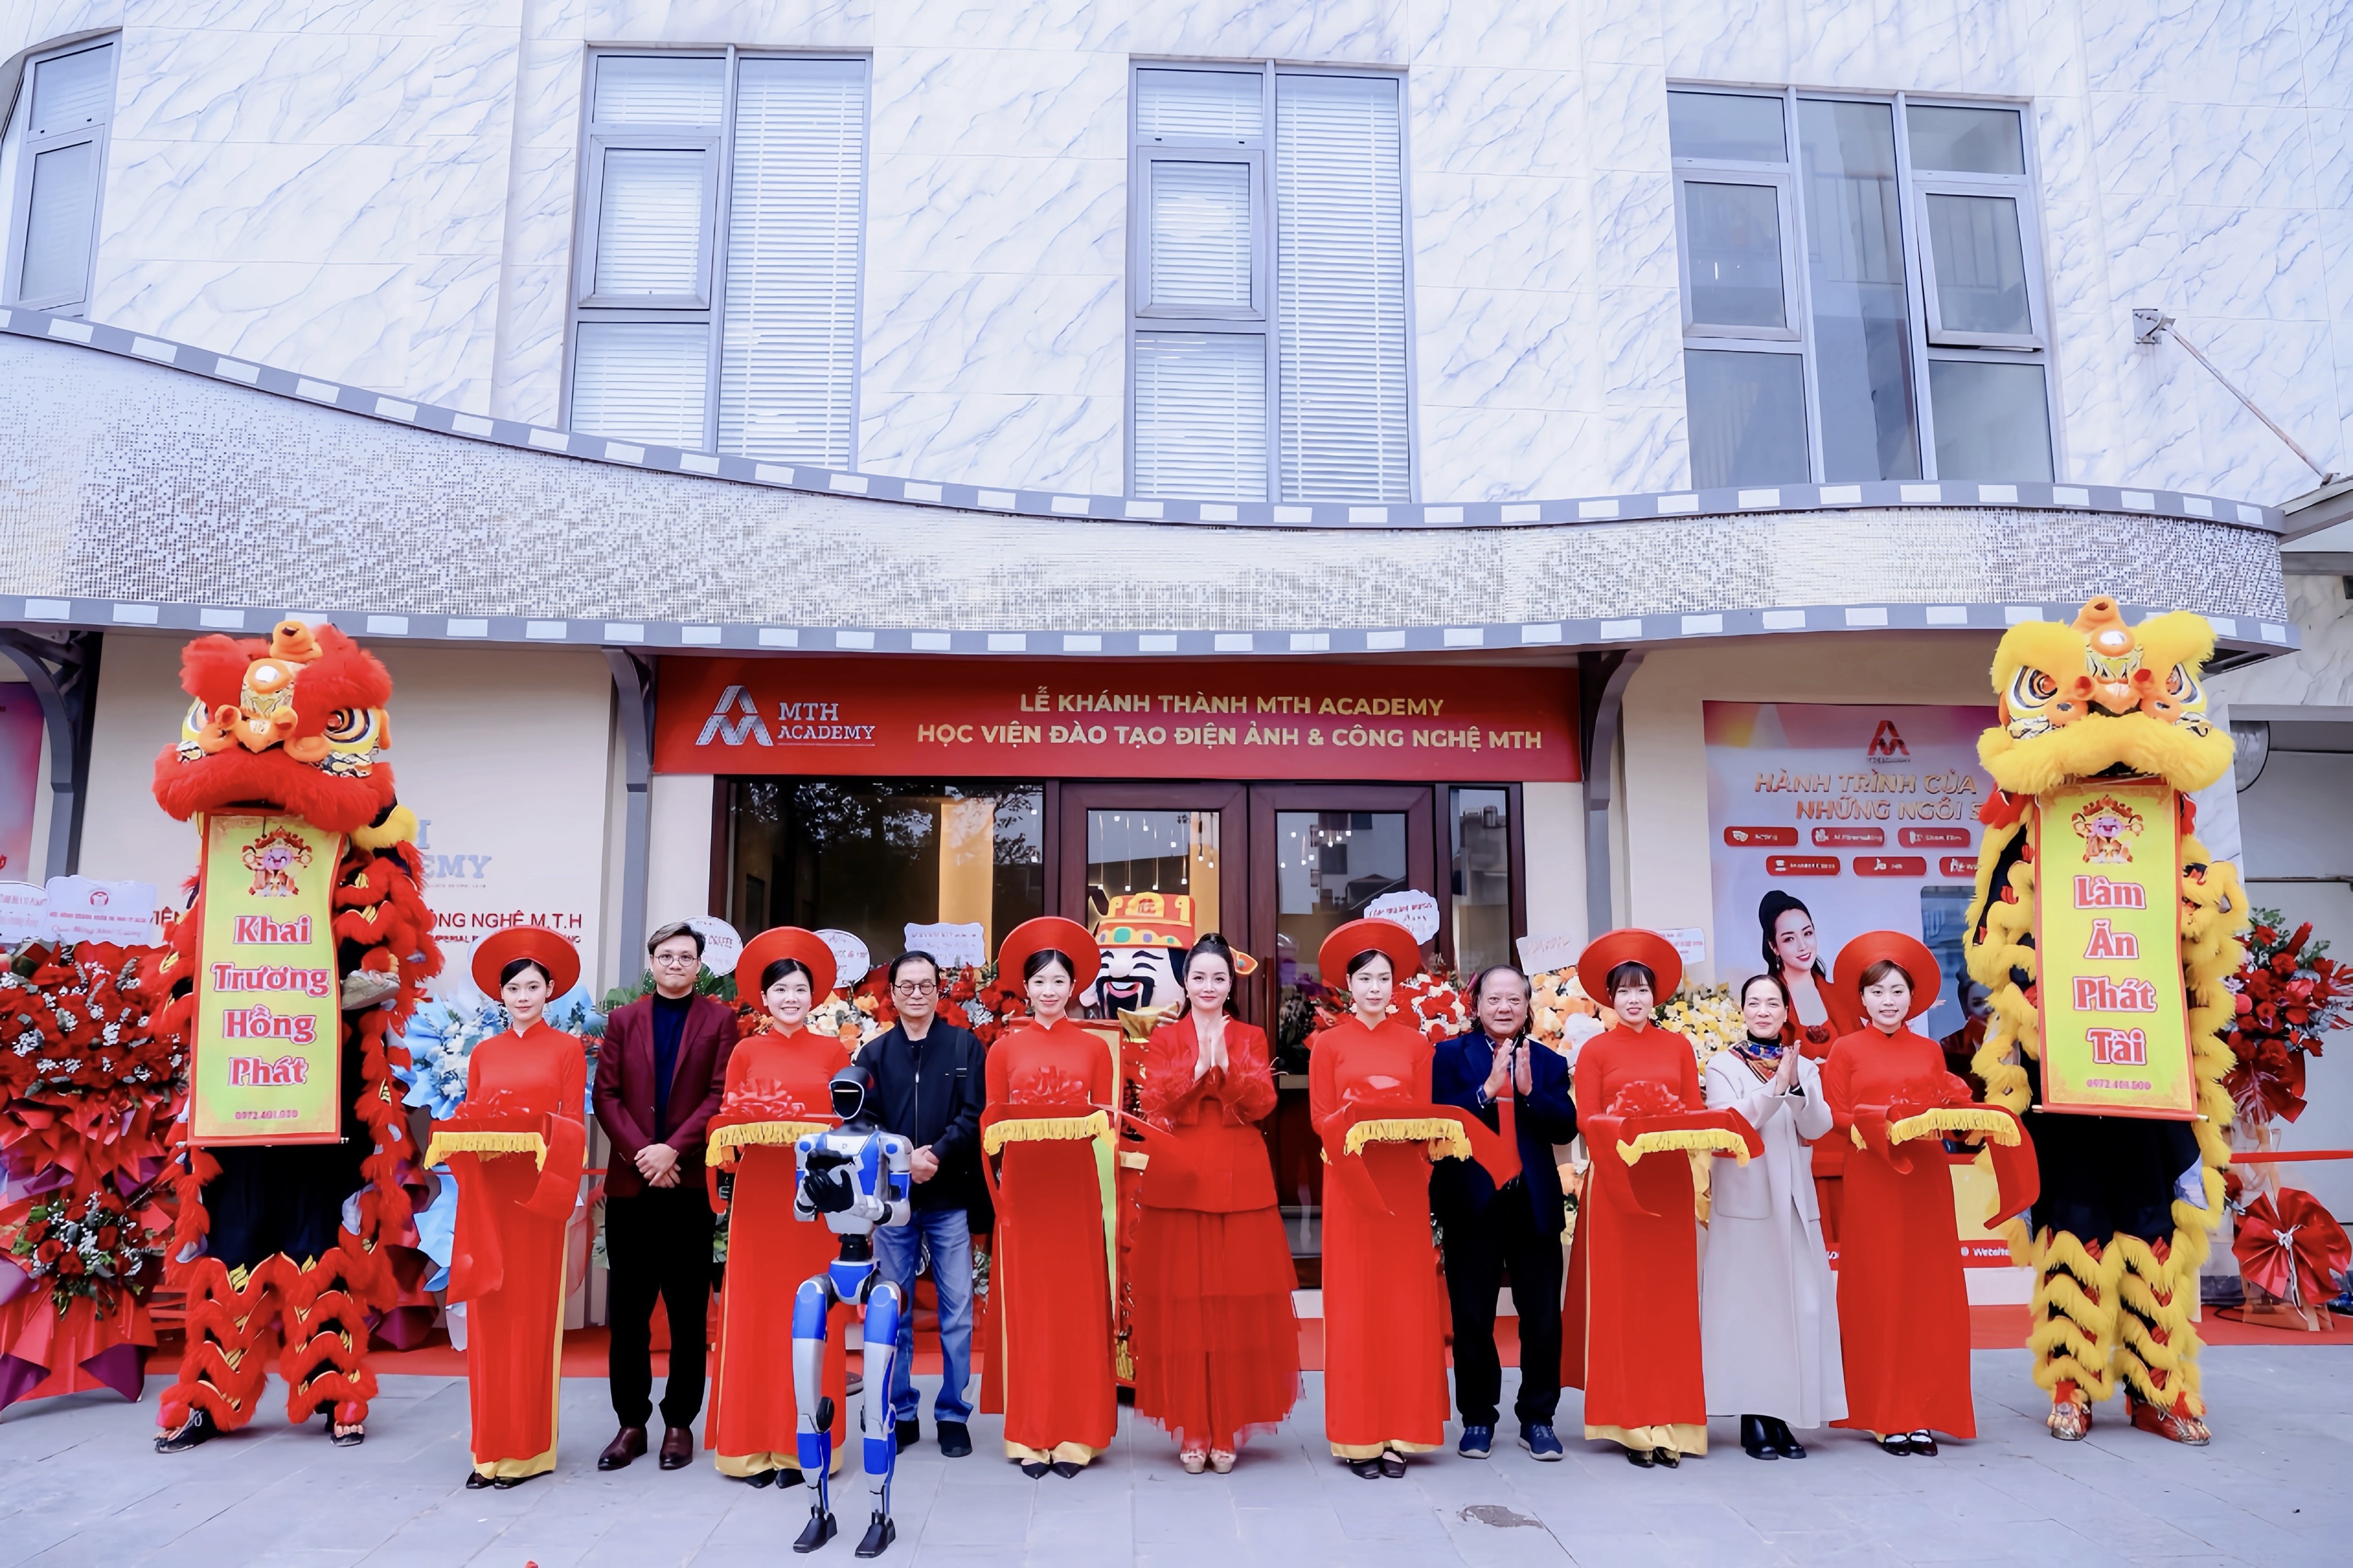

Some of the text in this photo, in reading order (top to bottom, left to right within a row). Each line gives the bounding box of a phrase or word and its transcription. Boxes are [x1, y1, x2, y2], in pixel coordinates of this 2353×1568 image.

[778, 702, 839, 721] MTH
[1020, 686, 1444, 716] LỄ KHÁNH THÀNH MTH ACADEMY
[778, 725, 876, 740] ACADEMY
[918, 720, 1542, 752] HỌC VIỆN ĐÀO TẠO ĐIỆN ẢNH & CÔNG NGHỆ MTH
[1754, 768, 1977, 794] HÀNH TRÌNH CỦA
[1796, 796, 1891, 820] NHỮNG
[1898, 797, 1963, 820] NGÔI
[2074, 875, 2146, 909] Làm
[233, 915, 312, 944] Khai
[2084, 919, 2139, 960] Ăn
[211, 962, 331, 998] Trương
[2073, 976, 2158, 1013] Phát
[222, 1005, 317, 1045] Hồng
[2086, 1028, 2147, 1065] Tài
[229, 1056, 309, 1086] Phát
